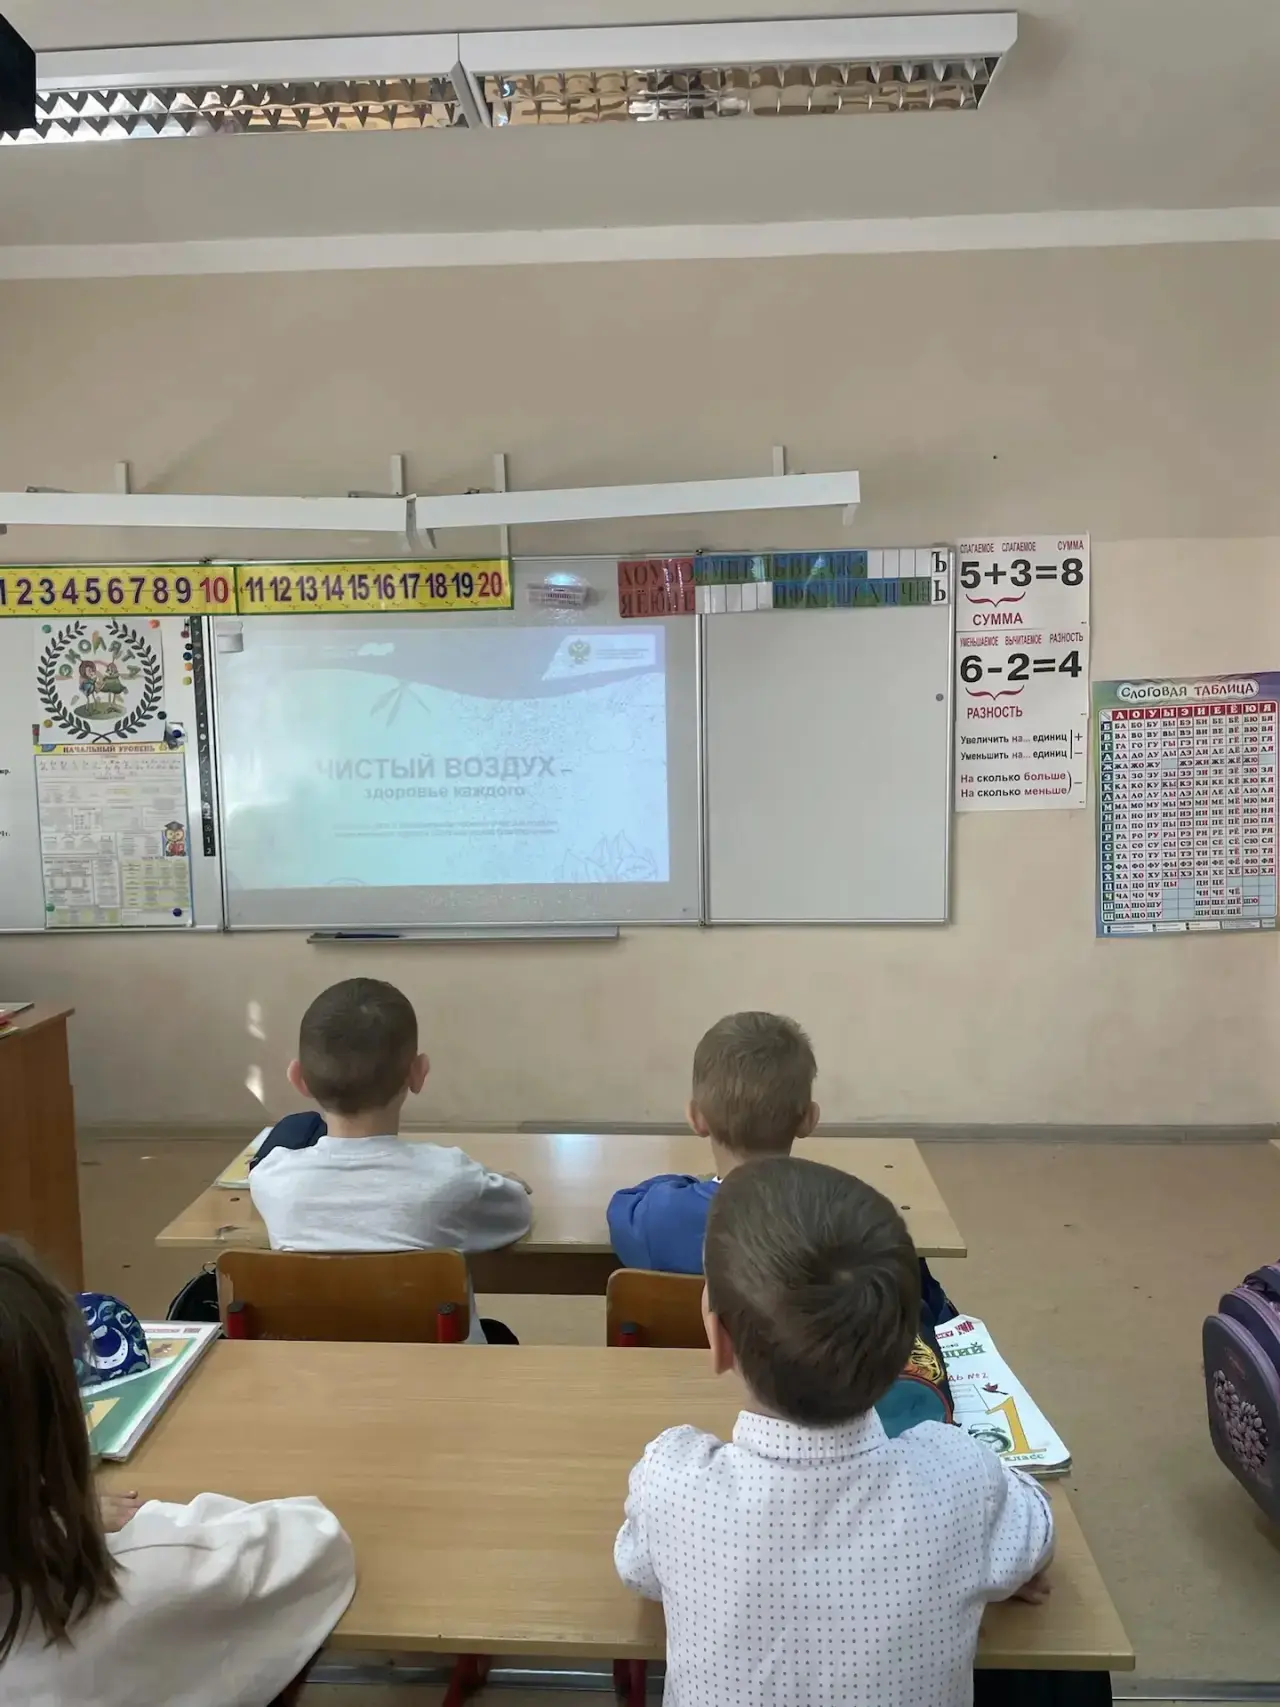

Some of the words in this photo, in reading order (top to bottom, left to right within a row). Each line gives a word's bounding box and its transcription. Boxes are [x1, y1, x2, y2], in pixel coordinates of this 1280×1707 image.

[960, 543, 994, 554] СЛАГАЕМОЕ
[1002, 542, 1036, 552] СЛАГАЕМОЕ
[1057, 540, 1084, 550] СУММА
[960, 558, 1084, 589] 5+3=8
[16, 578, 32, 604] 2
[39, 578, 55, 604] 3
[62, 578, 78, 604] 4
[86, 578, 100, 604] 5
[108, 577, 123, 604] 6
[130, 577, 145, 604] 7
[153, 577, 169, 603] 8
[175, 577, 192, 603] 9
[200, 576, 228, 603] 10
[246, 576, 264, 602] 11
[269, 576, 292, 602] 12
[296, 576, 318, 601] 13
[321, 575, 344, 601] 14
[348, 574, 370, 600] 15
[373, 574, 395, 600] 16
[400, 573, 420, 599] 17
[426, 573, 448, 598] 18
[451, 572, 473, 598] 19
[478, 571, 502, 598] 20
[972, 612, 1023, 626] СУММА
[960, 636, 999, 647] УМЕНЬШАЕМОЕ
[1005, 634, 1042, 645] ВЫЧИТАЕМОЕ
[1050, 632, 1083, 643] РАЗНОСТЬ
[967, 706, 1023, 719] РАЗНОСТЬ
[961, 736, 1009, 744] Увеличить
[1033, 733, 1067, 742] единиц
[961, 752, 1009, 760] Уменьшить
[1033, 750, 1067, 758] единиц
[444, 756, 556, 781] ВОЗДУХ
[961, 775, 974, 783] На
[977, 774, 1021, 782] сколько
[1024, 772, 1066, 781] больше
[364, 786, 448, 801] здоровье
[454, 785, 525, 799] каждого
[961, 789, 974, 797] На
[977, 789, 1021, 797] сколько
[1024, 787, 1067, 796] меньше
[984, 1396, 1046, 1456] 1
